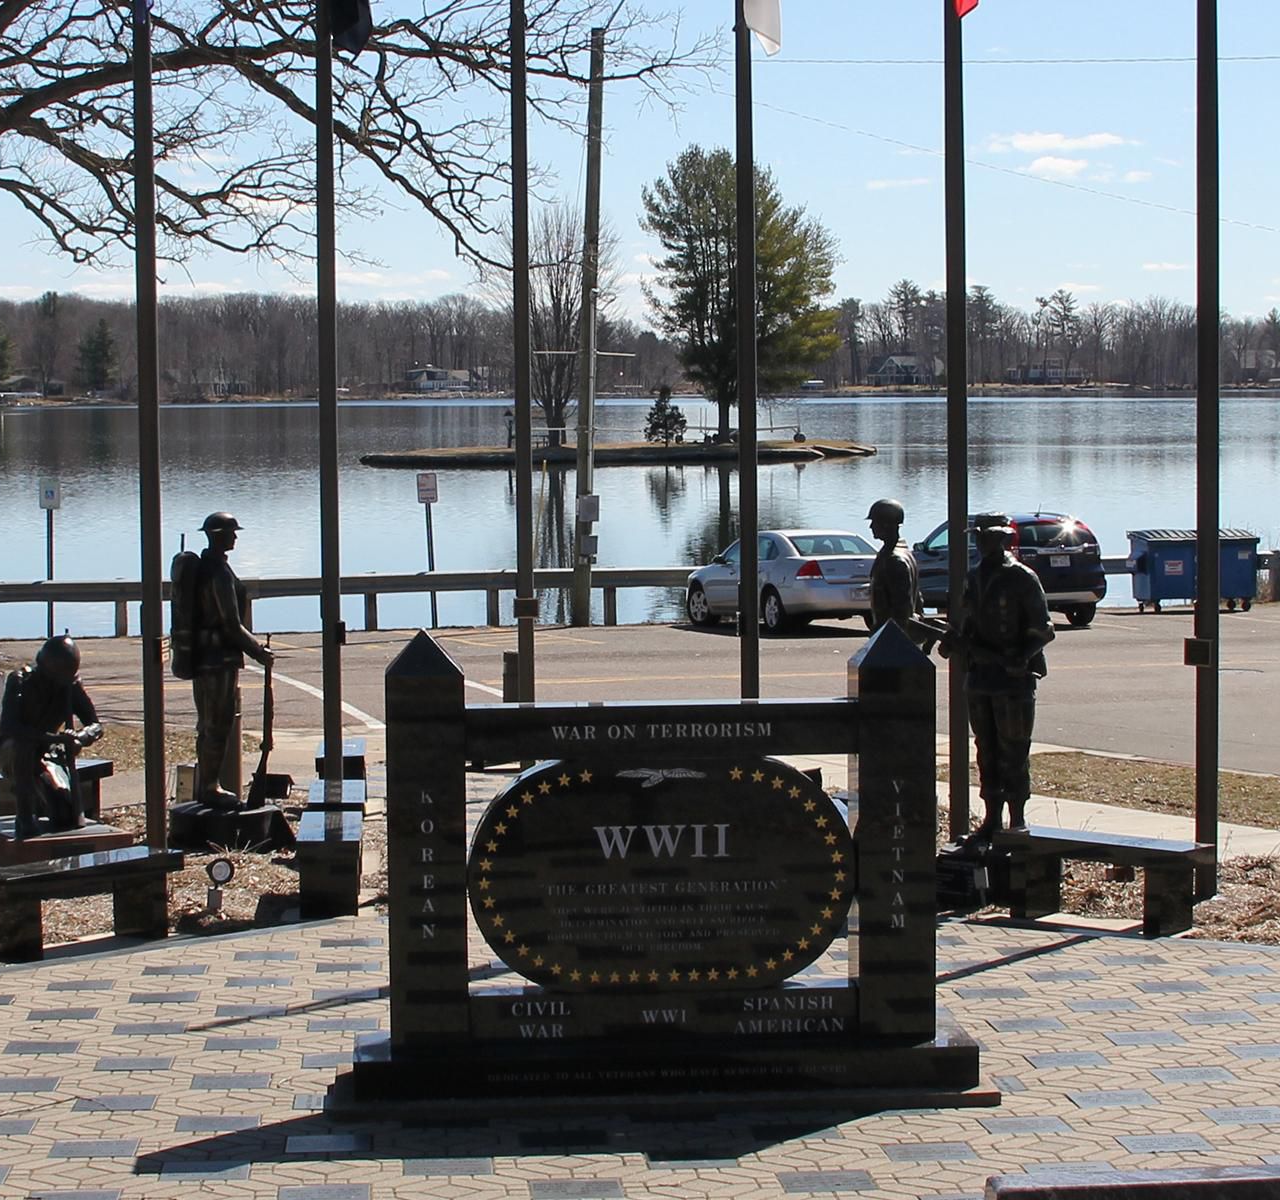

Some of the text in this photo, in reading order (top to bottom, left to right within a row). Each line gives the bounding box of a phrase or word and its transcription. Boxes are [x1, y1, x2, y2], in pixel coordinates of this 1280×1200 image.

[552, 722, 773, 741] WAR ON TERRORISM
[594, 823, 731, 860] WWII
[890, 780, 906, 929] VIETNAM
[420, 791, 436, 940] KOREAN
[585, 881, 669, 895] GREATEST
[511, 1001, 571, 1017] CIVIL
[743, 995, 834, 1012] SPANISH
[642, 1008, 688, 1024] WWI
[519, 1022, 564, 1039] WAR
[734, 1016, 845, 1034] AMERICAN
